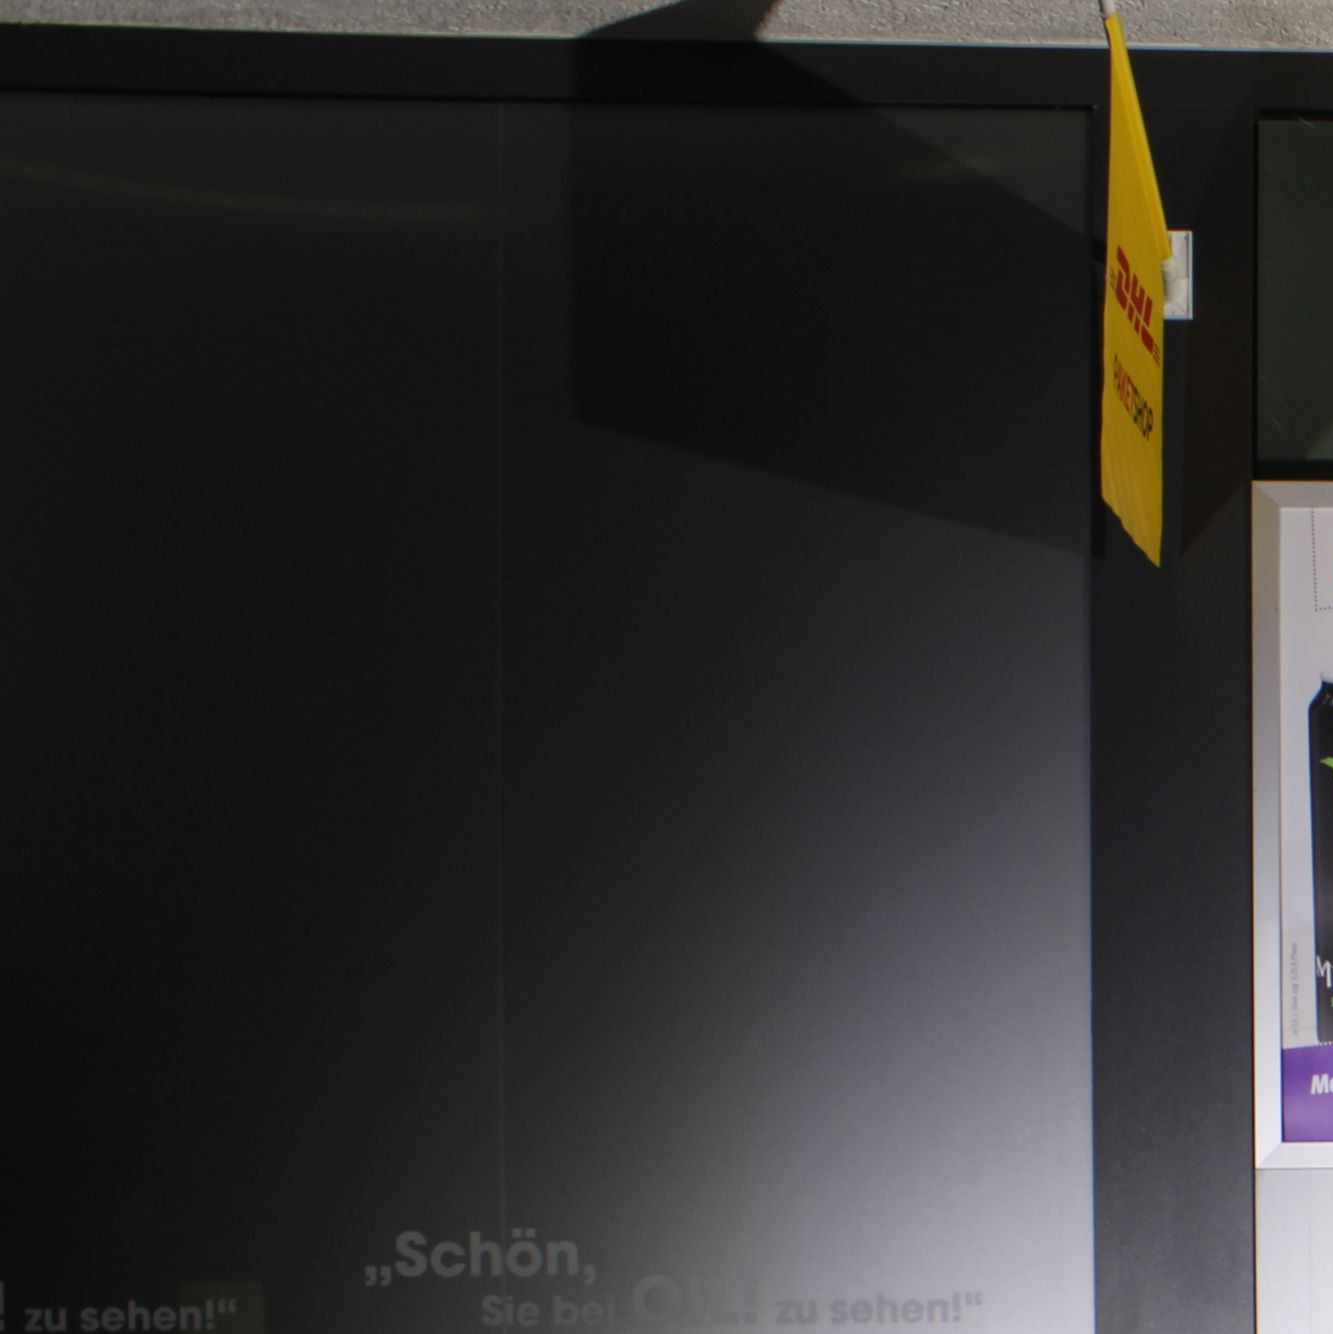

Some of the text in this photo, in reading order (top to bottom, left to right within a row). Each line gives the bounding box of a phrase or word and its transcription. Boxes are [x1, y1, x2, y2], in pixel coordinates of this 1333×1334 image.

[1117, 245, 1154, 354] DHL
[24, 1306, 67, 1332] zu
[481, 1292, 539, 1327] Sie
[553, 1295, 615, 1327] bei
[776, 1299, 817, 1326] zu
